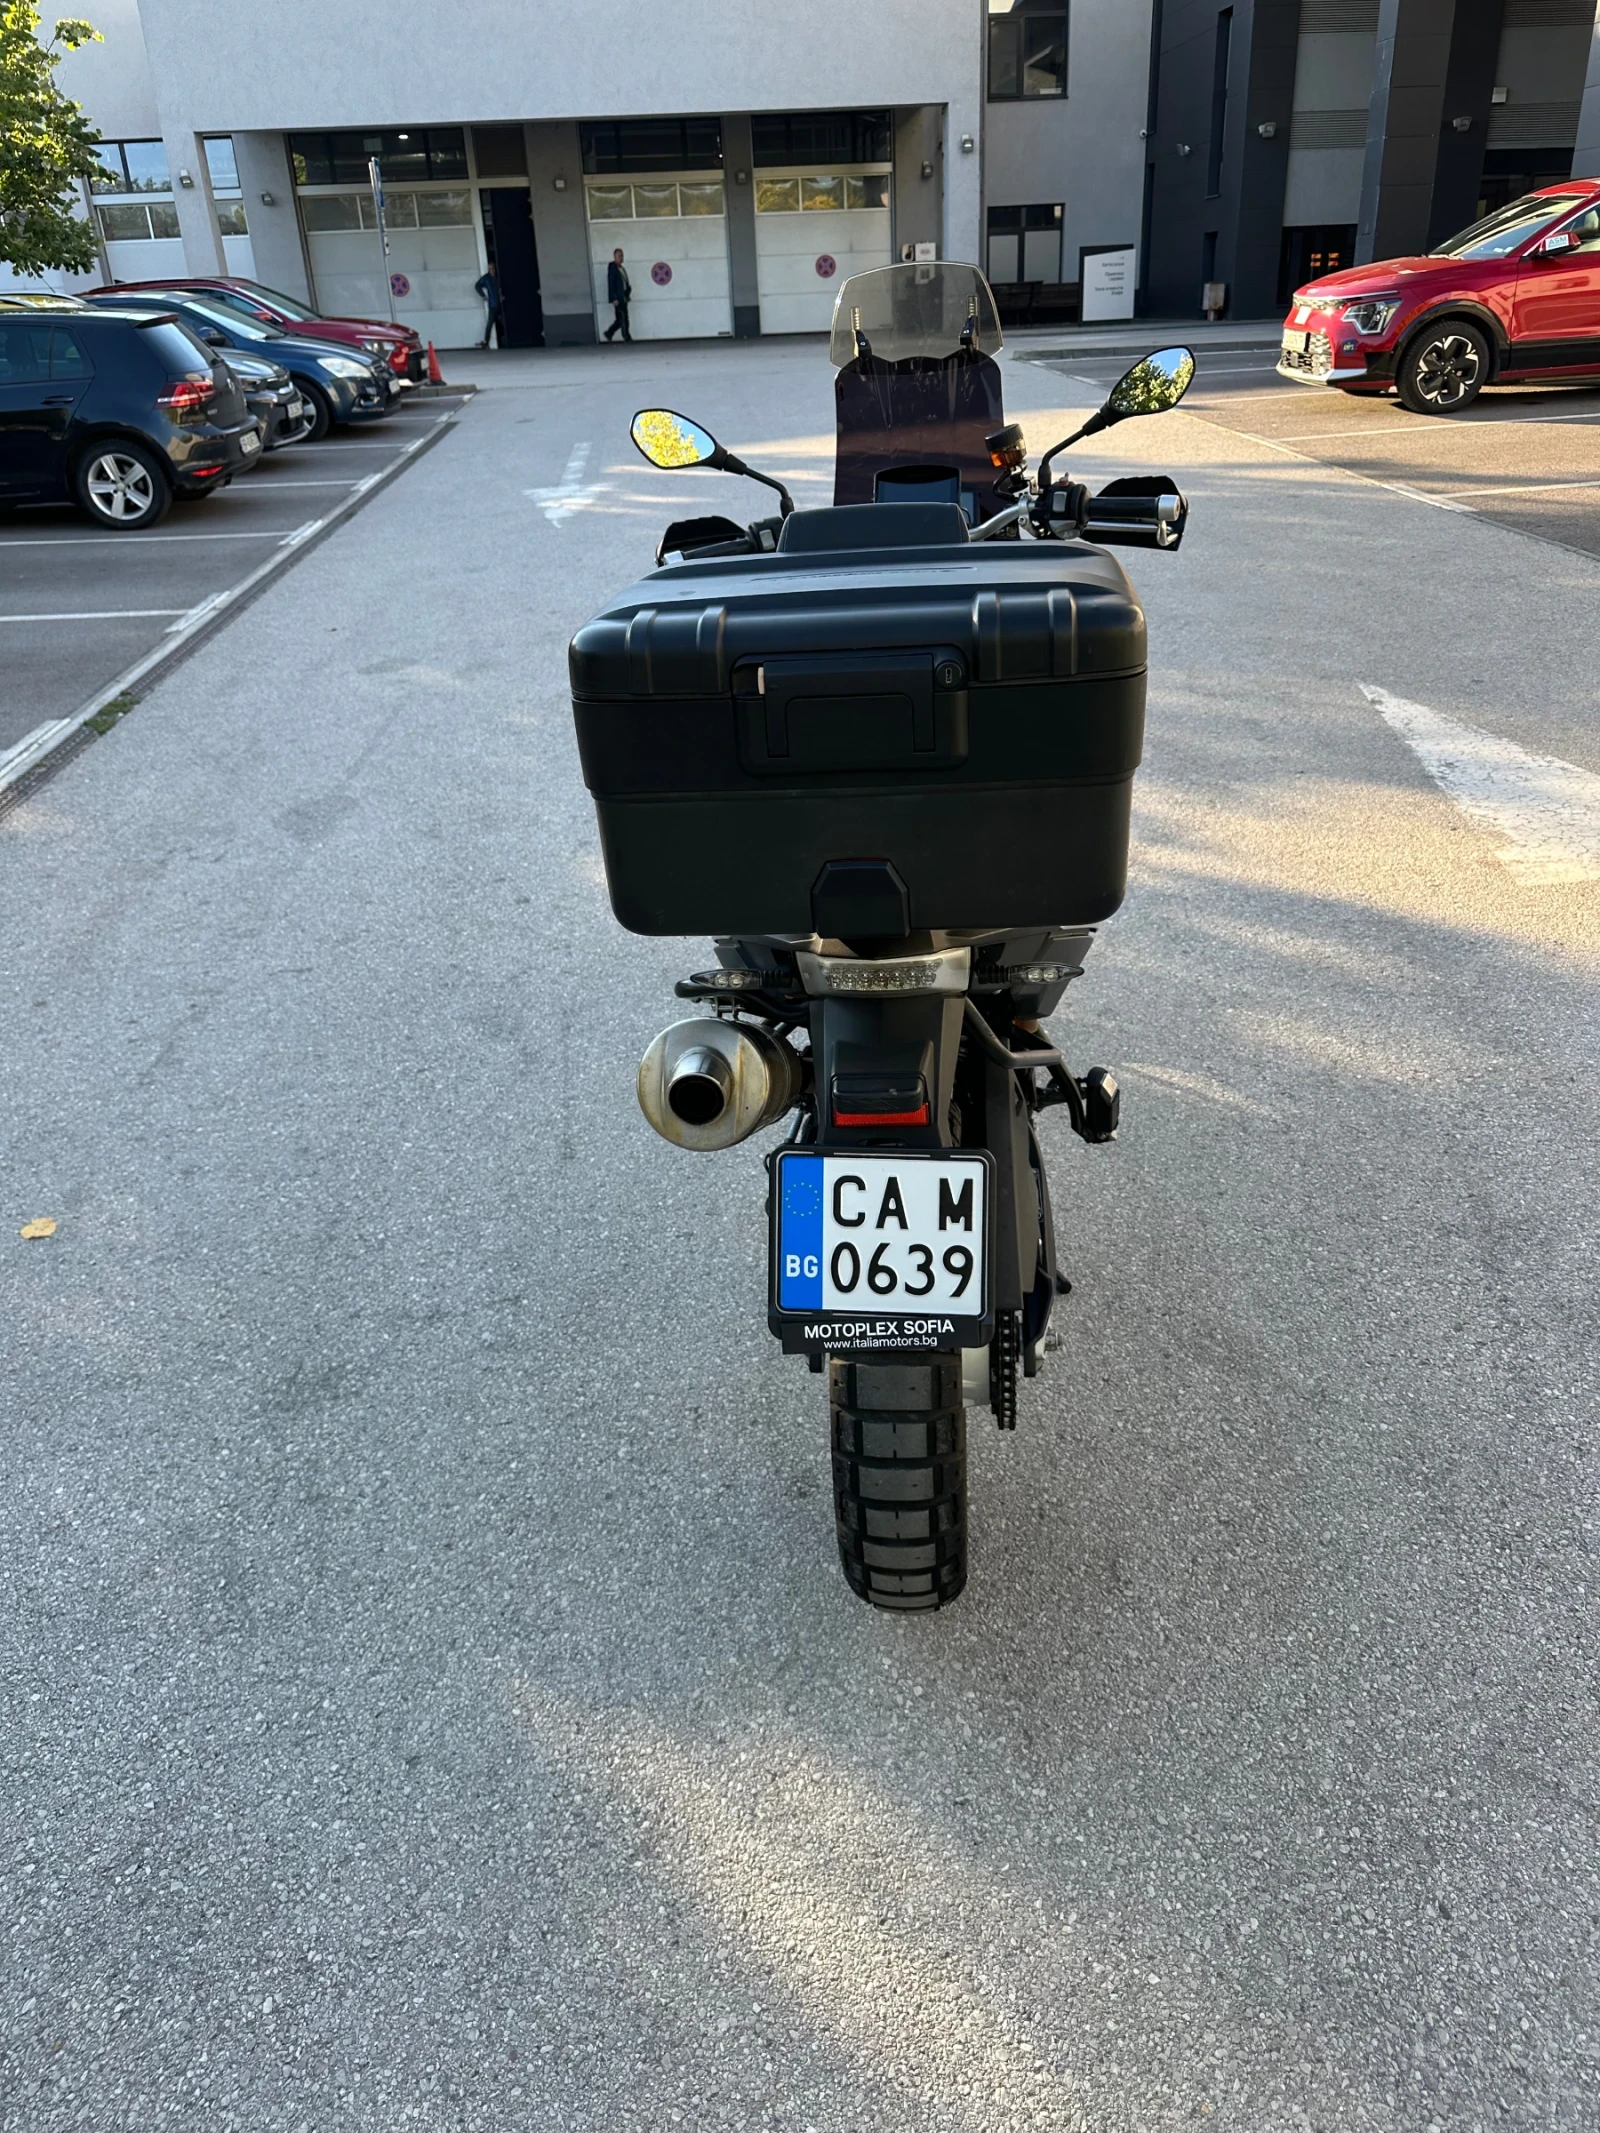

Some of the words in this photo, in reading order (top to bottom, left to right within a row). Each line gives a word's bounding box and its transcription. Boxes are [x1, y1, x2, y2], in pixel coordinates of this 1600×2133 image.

[832, 1175, 909, 1230] CA
[938, 1177, 974, 1232] M
[785, 1254, 819, 1278] BG
[830, 1241, 974, 1298] 0639
[804, 1321, 899, 1339] MOTOPLEX
[903, 1318, 955, 1335] SOFIA
[823, 1335, 938, 1349] www.italiamotors.bg
